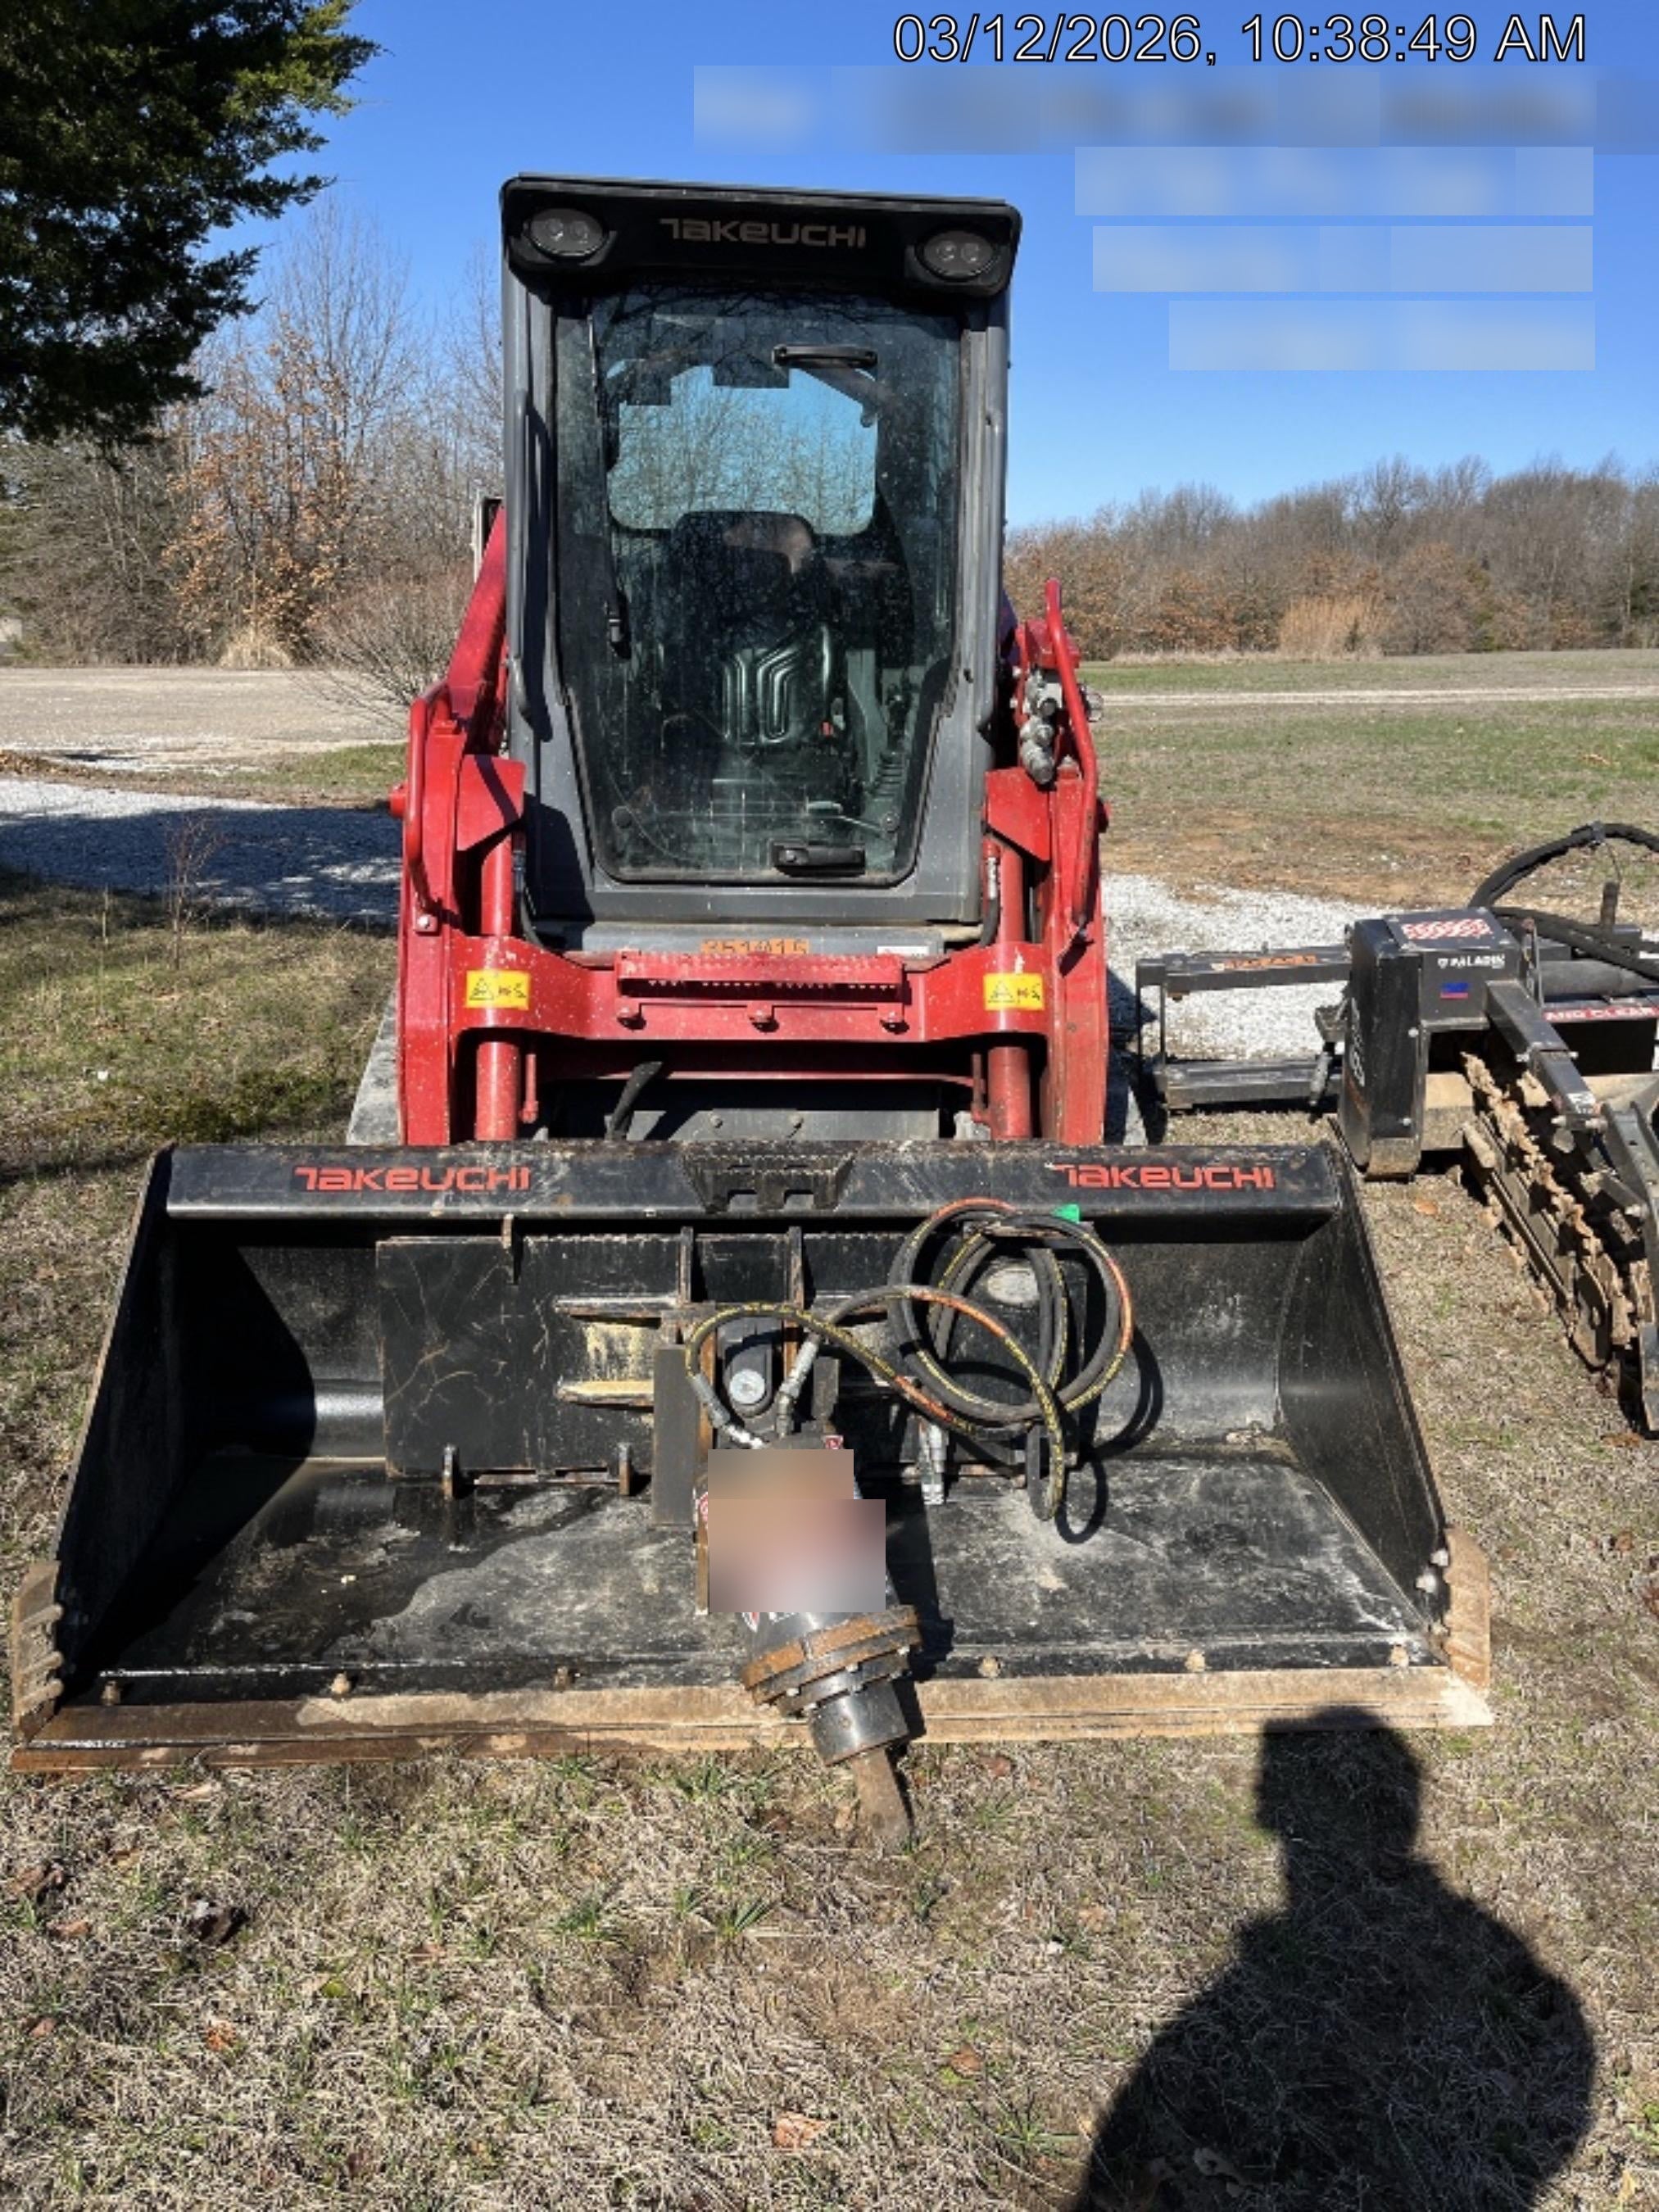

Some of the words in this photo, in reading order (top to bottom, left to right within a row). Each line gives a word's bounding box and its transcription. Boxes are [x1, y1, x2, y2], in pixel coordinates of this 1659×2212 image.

[659, 217, 866, 249] TAKEUCHI
[295, 1166, 531, 1190] TAKEUCHI
[1052, 1163, 1275, 1189] TAKEUCHI
